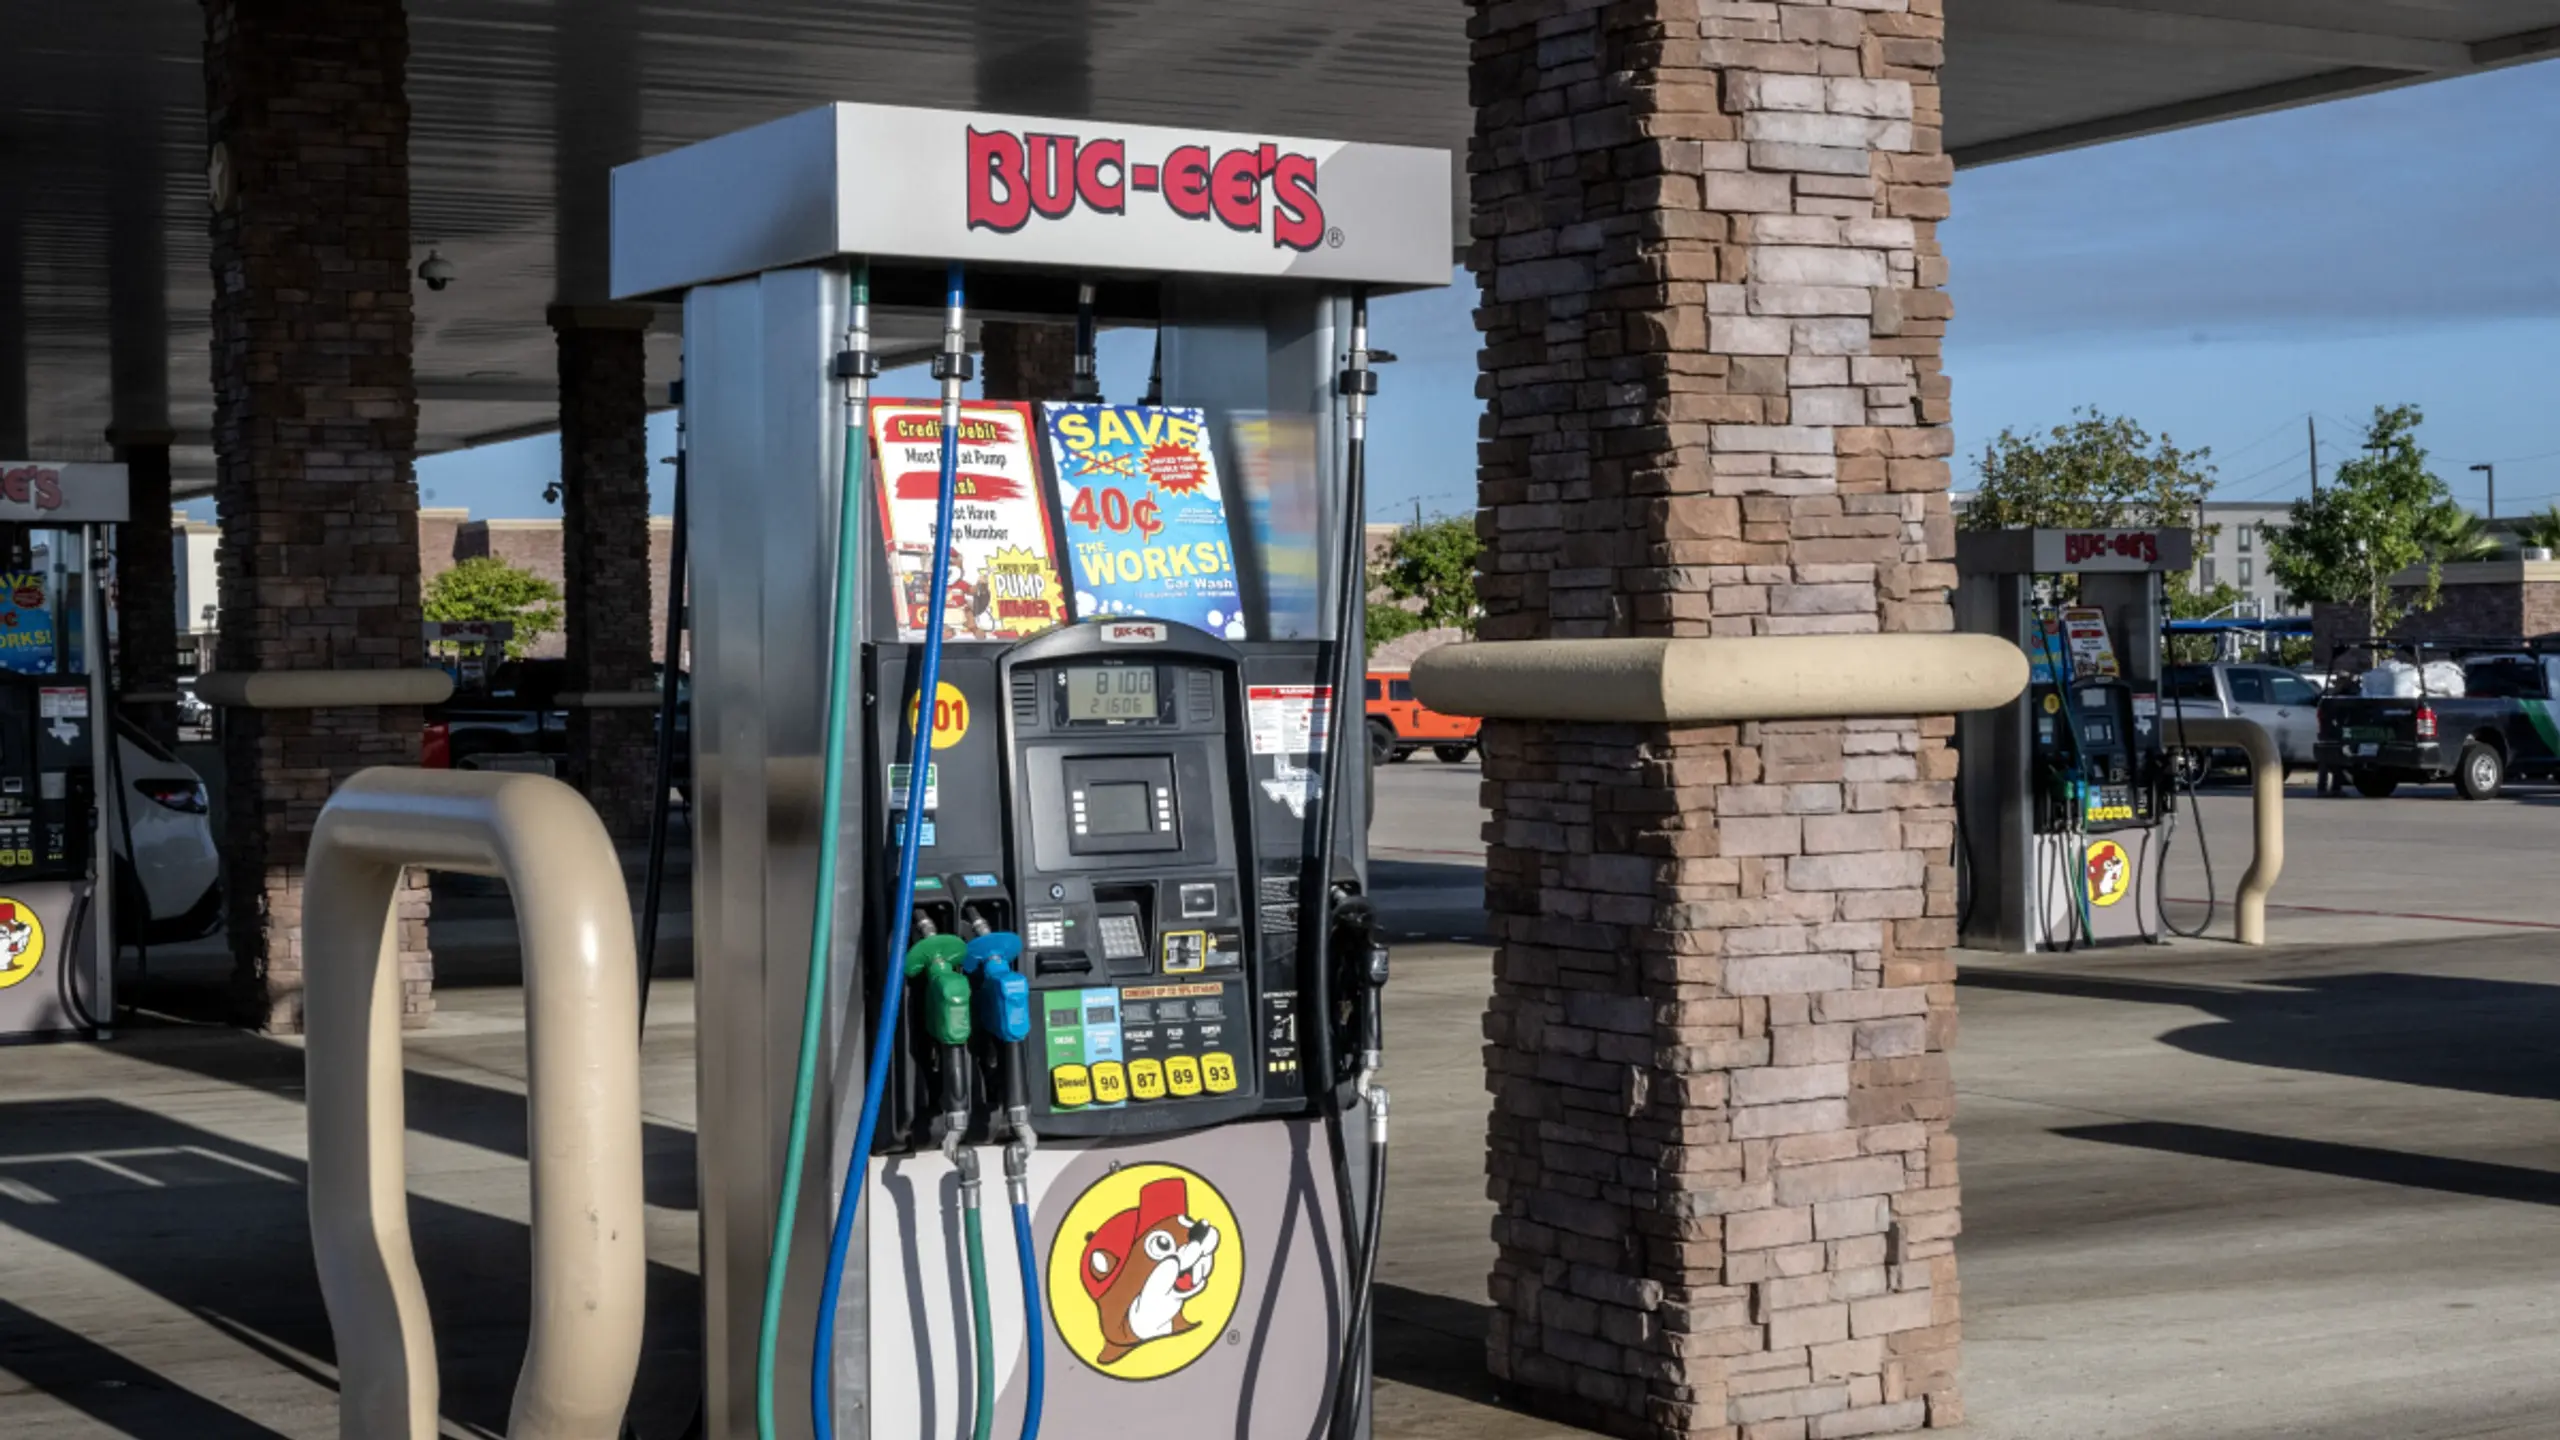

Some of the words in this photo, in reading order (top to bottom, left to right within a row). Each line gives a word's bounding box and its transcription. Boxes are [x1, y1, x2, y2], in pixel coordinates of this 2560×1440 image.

[898, 420, 941, 437] Credi
[1057, 409, 1200, 451] SAVE
[974, 450, 1007, 471] Pump
[1069, 486, 1166, 543] 40¢
[964, 524, 1009, 541] Number
[1076, 541, 1108, 555] THE
[1080, 540, 1232, 587] WORKS!
[995, 573, 1045, 600] PUMP
[1164, 578, 1189, 590] Car
[1194, 577, 1233, 590] Wash
[1058, 671, 1067, 687] $
[914, 699, 964, 732] 01
[1137, 1072, 1157, 1088] 87
[1173, 1069, 1194, 1085] 89
[1209, 1066, 1231, 1082] 93
[1100, 1076, 1119, 1091] 90
